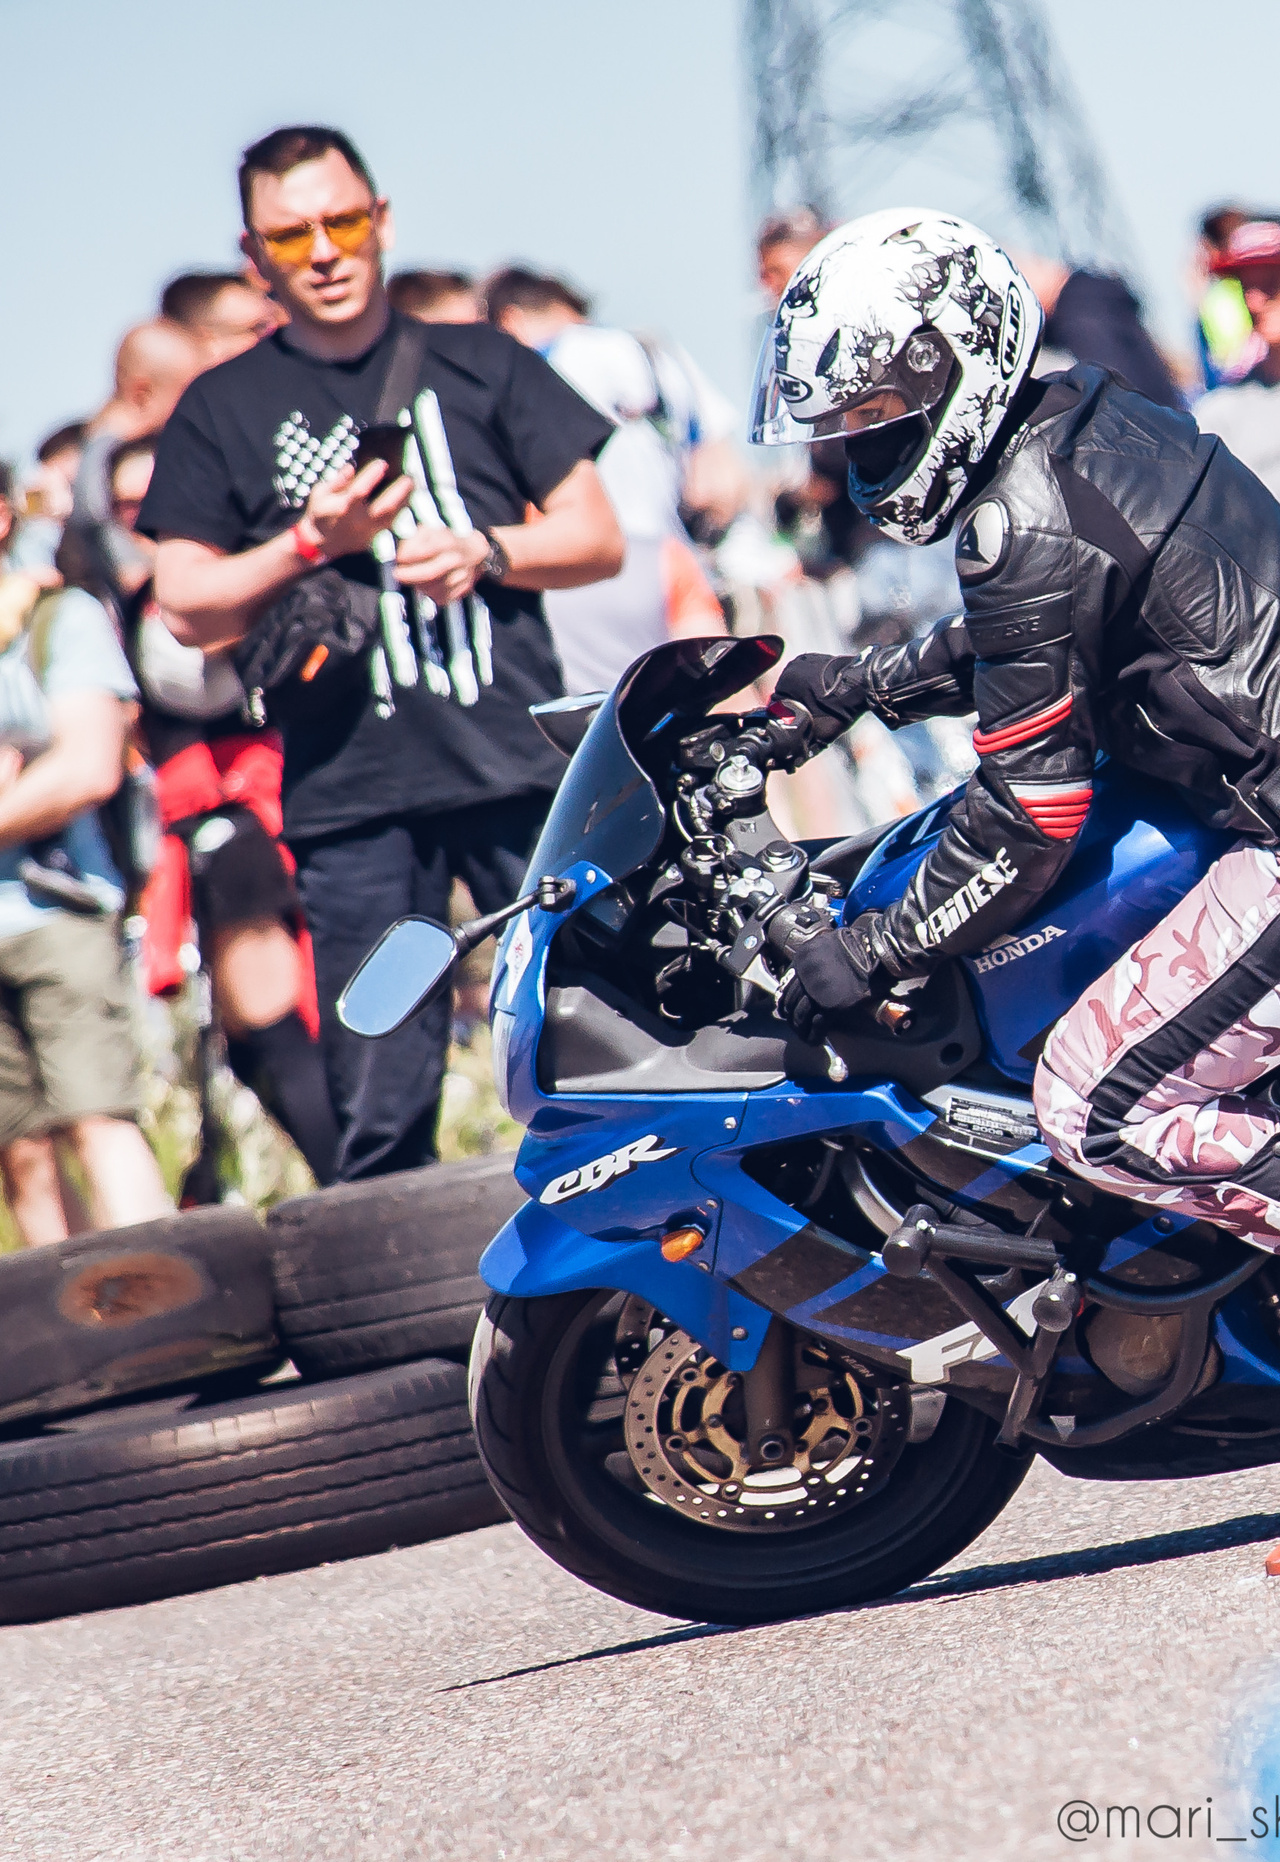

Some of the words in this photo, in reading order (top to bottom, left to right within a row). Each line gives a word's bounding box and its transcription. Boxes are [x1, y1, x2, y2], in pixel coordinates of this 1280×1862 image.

[1004, 293, 1021, 368] HJC
[973, 925, 1067, 974] HONDA
[539, 1134, 683, 1206] CBR
